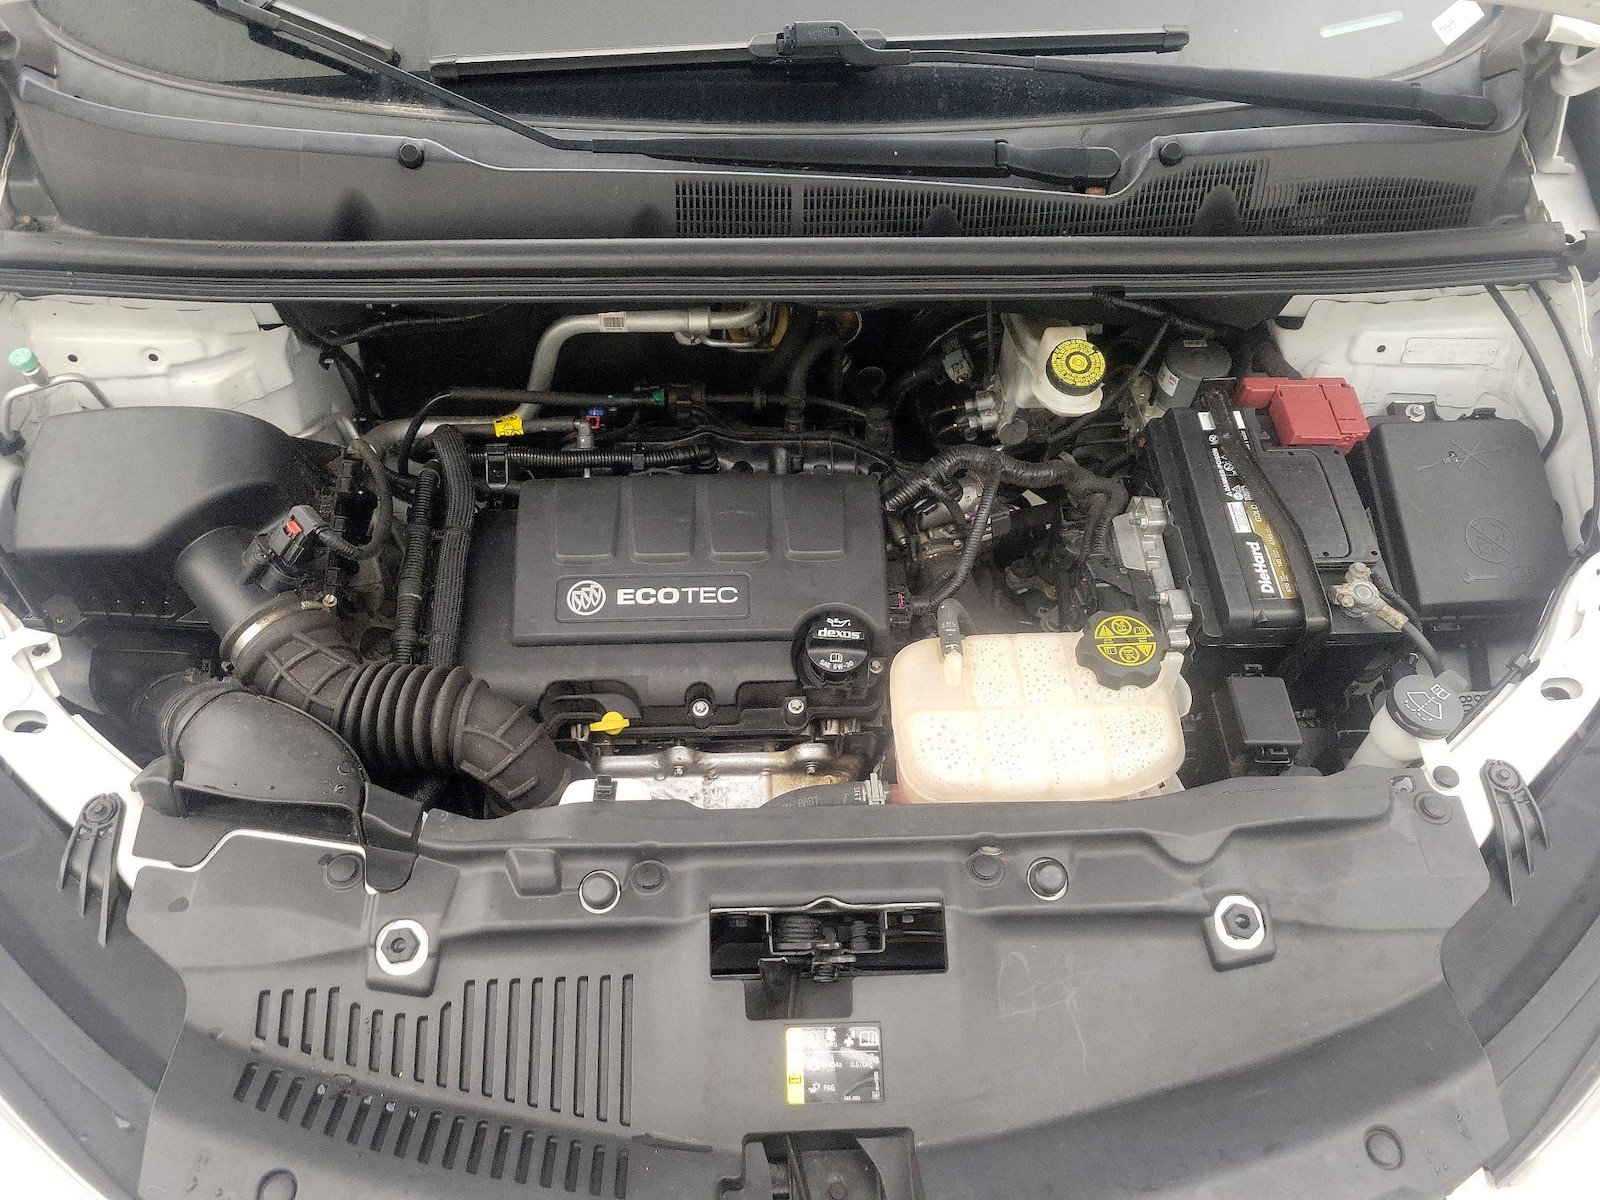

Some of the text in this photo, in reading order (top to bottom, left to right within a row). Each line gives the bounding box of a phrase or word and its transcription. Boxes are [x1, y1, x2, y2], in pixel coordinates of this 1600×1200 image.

[1250, 504, 1263, 522] GOLD
[1245, 541, 1275, 594] DieHard
[616, 586, 739, 605] ECOTEC
[817, 627, 862, 639] dexos
[819, 659, 855, 670] SAE 5W-30
[823, 1083, 836, 1092] PAG
